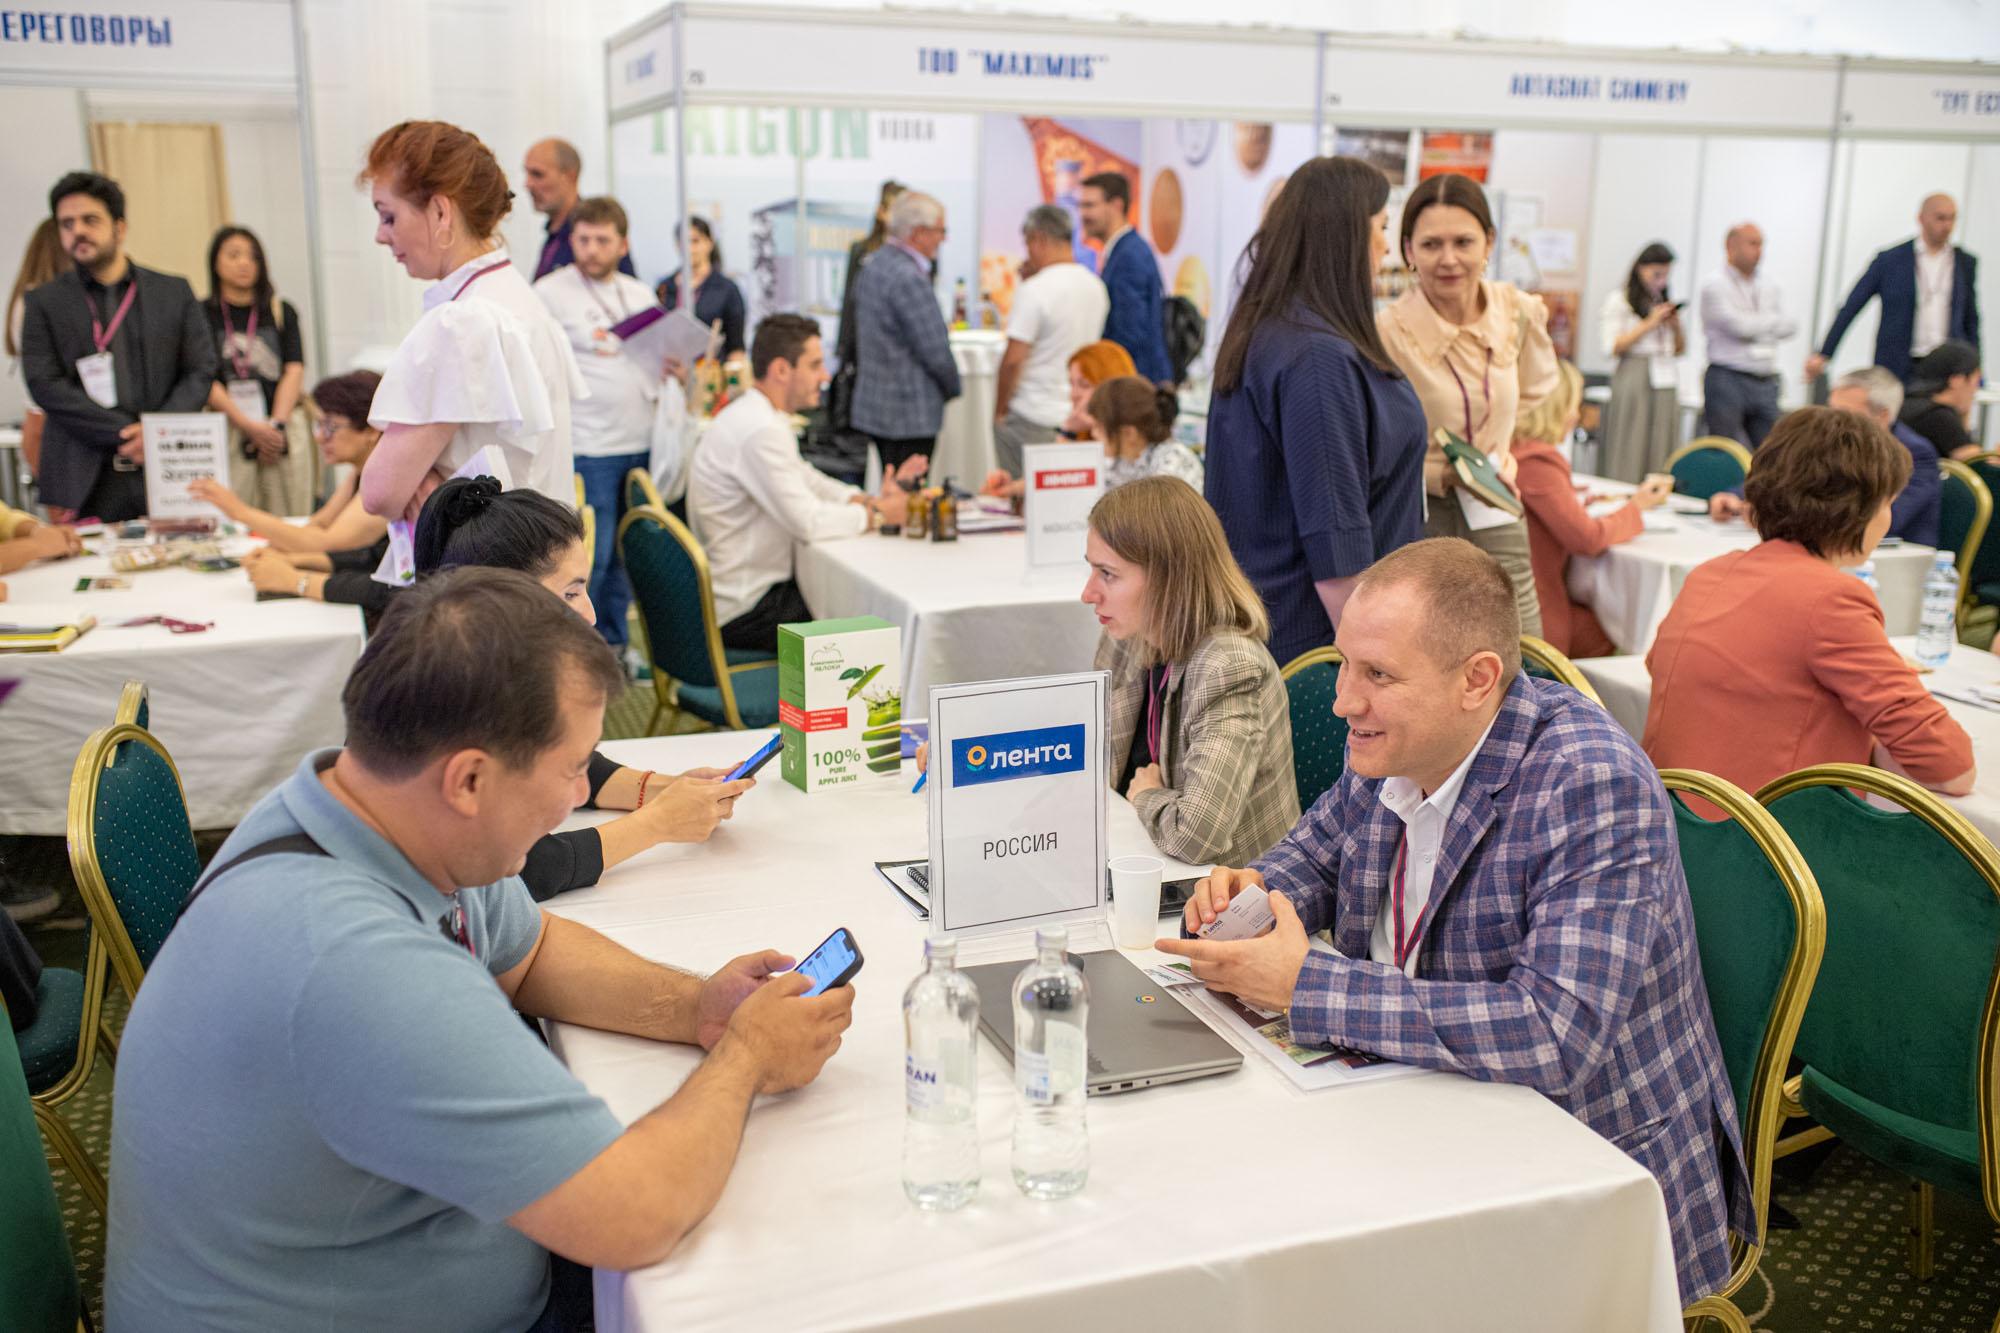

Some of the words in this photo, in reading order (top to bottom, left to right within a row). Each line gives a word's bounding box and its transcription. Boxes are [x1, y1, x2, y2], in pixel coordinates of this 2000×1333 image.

[0, 11, 172, 46] ЕРЕГОВОРЫ
[813, 747, 861, 767] 100%
[990, 743, 1073, 770] лента
[818, 776, 838, 786] APPLE
[841, 774, 857, 783] JUICE
[829, 766, 847, 775] PURE
[983, 831, 1058, 861] РОССИЯ
